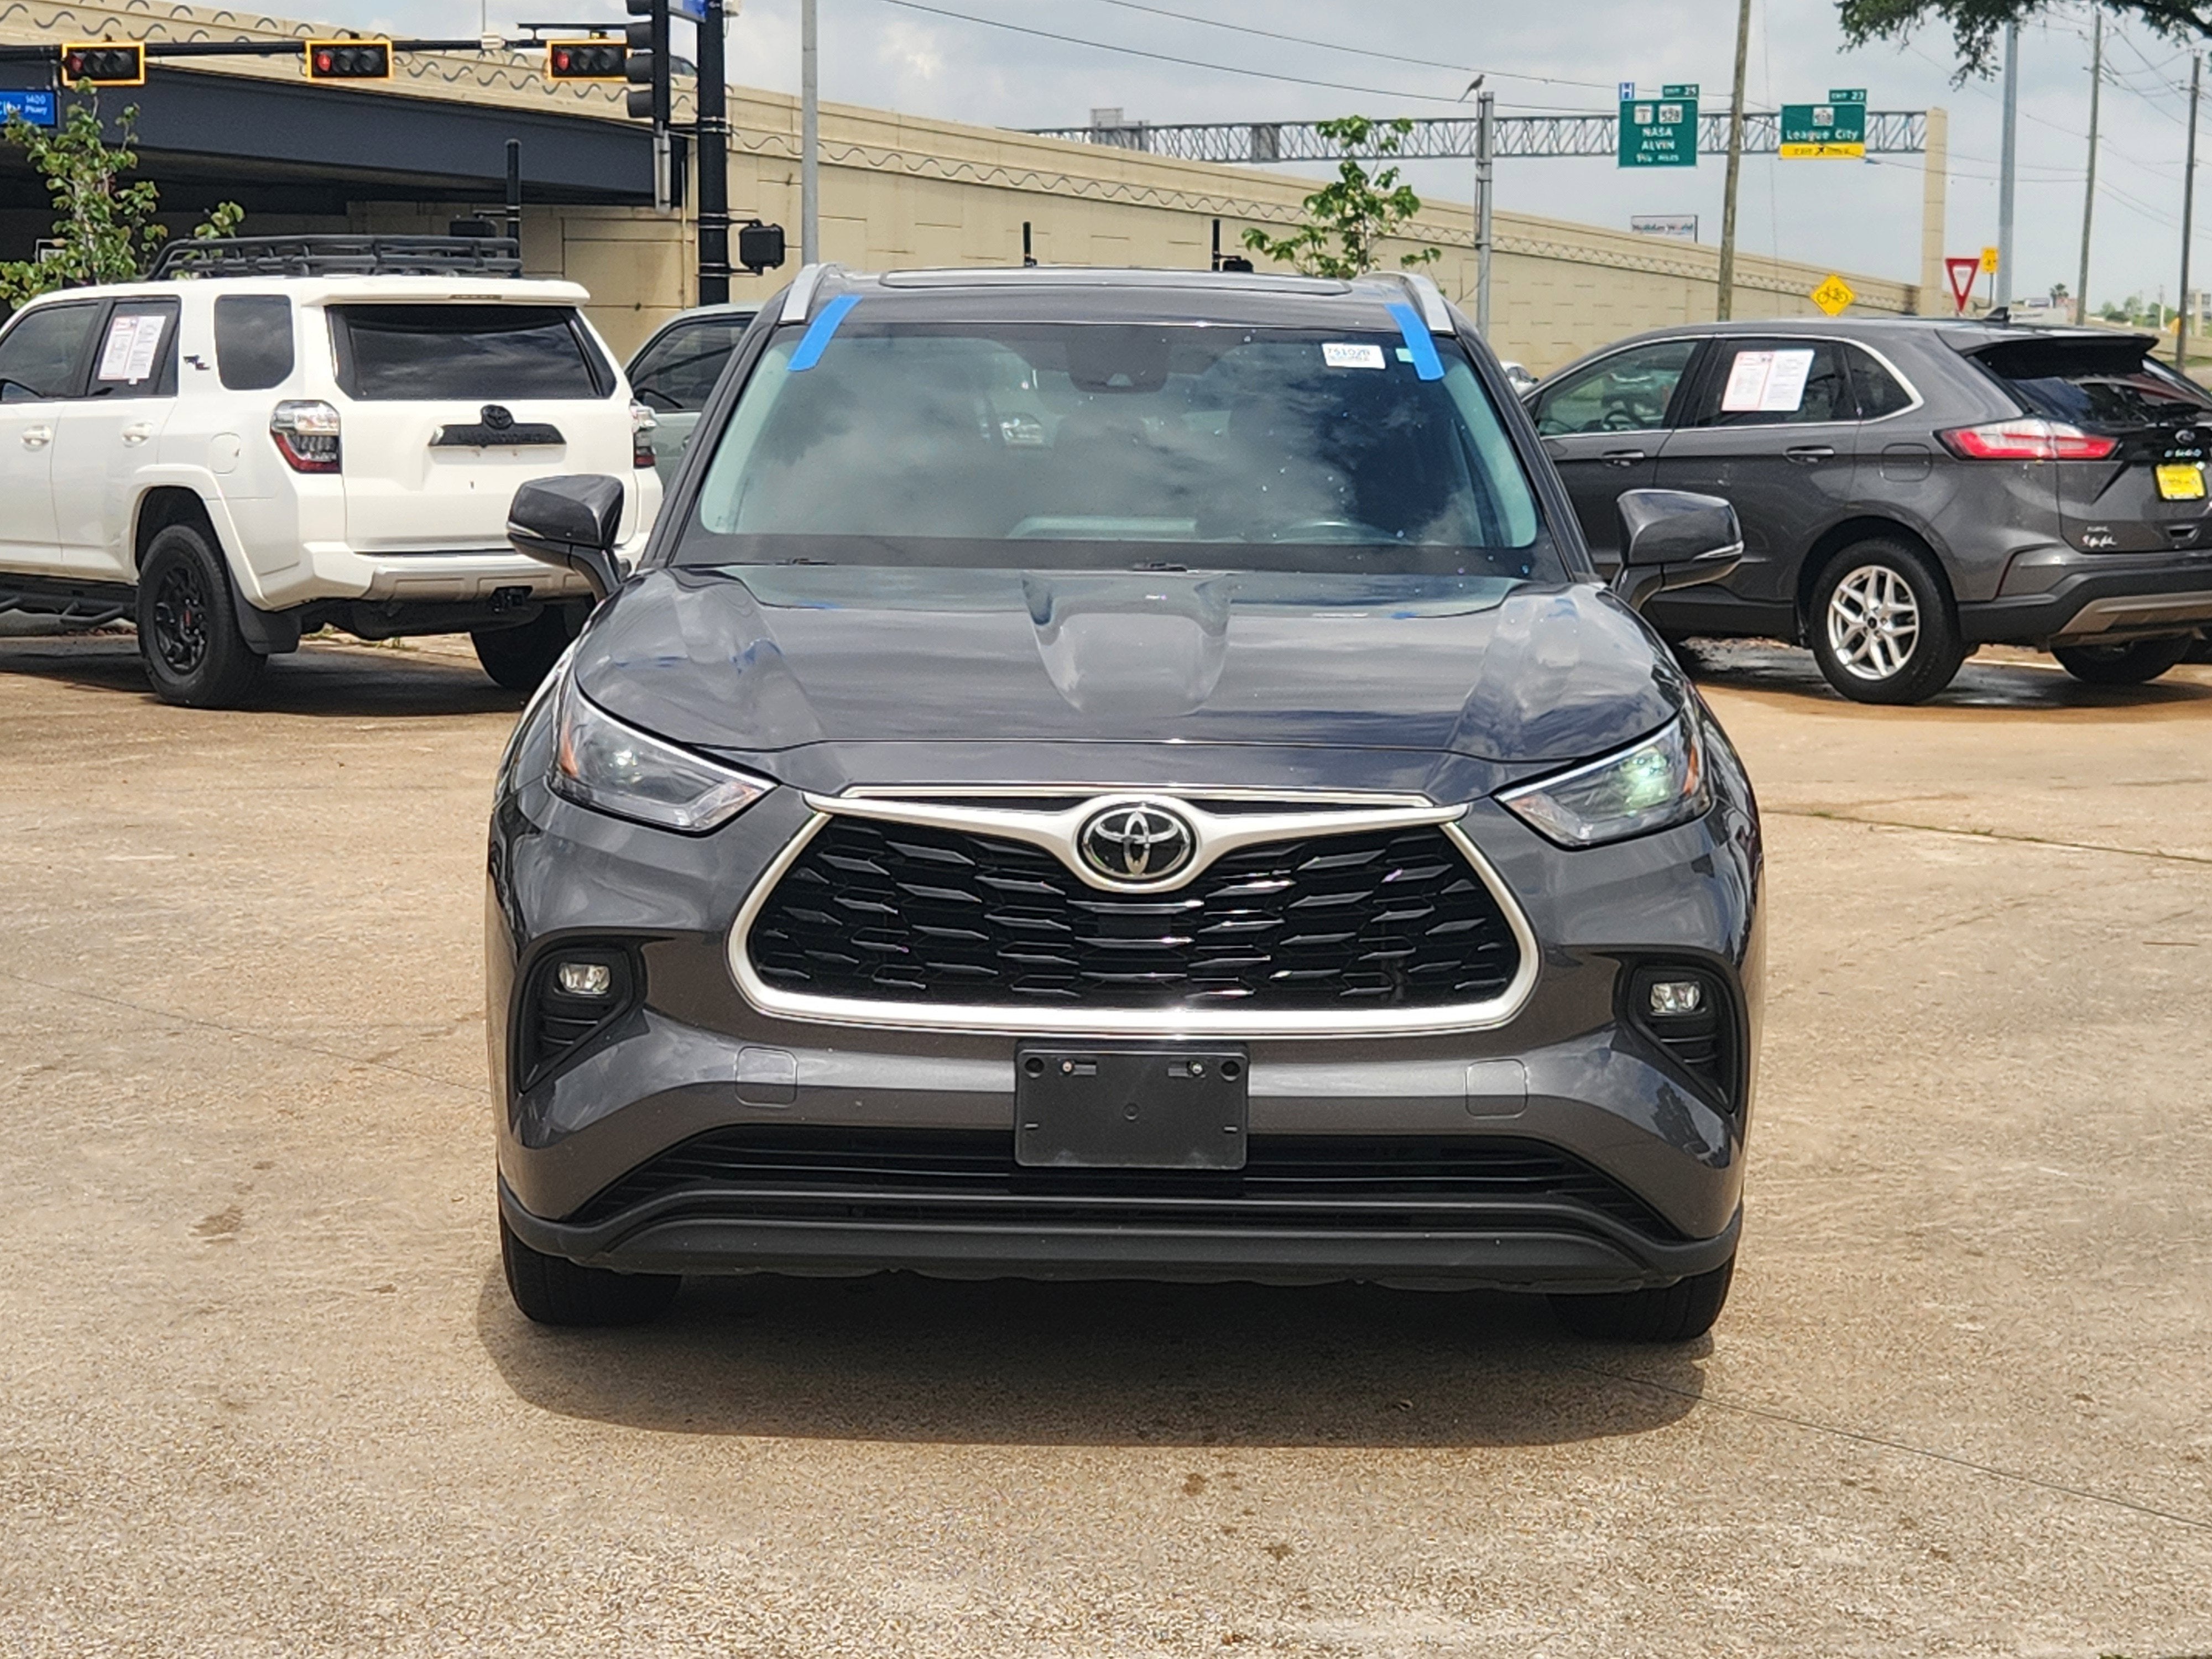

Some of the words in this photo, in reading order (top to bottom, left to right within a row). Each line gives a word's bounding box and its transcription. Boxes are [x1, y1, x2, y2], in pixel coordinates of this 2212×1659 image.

[1621, 83, 1632, 99] H
[1851, 91, 1864, 100] 23
[1661, 110, 1679, 122] 528
[1642, 127, 1673, 137] NASA
[1786, 129, 1830, 142] League
[1835, 129, 1859, 142] City
[1641, 140, 1675, 151] ALVIN
